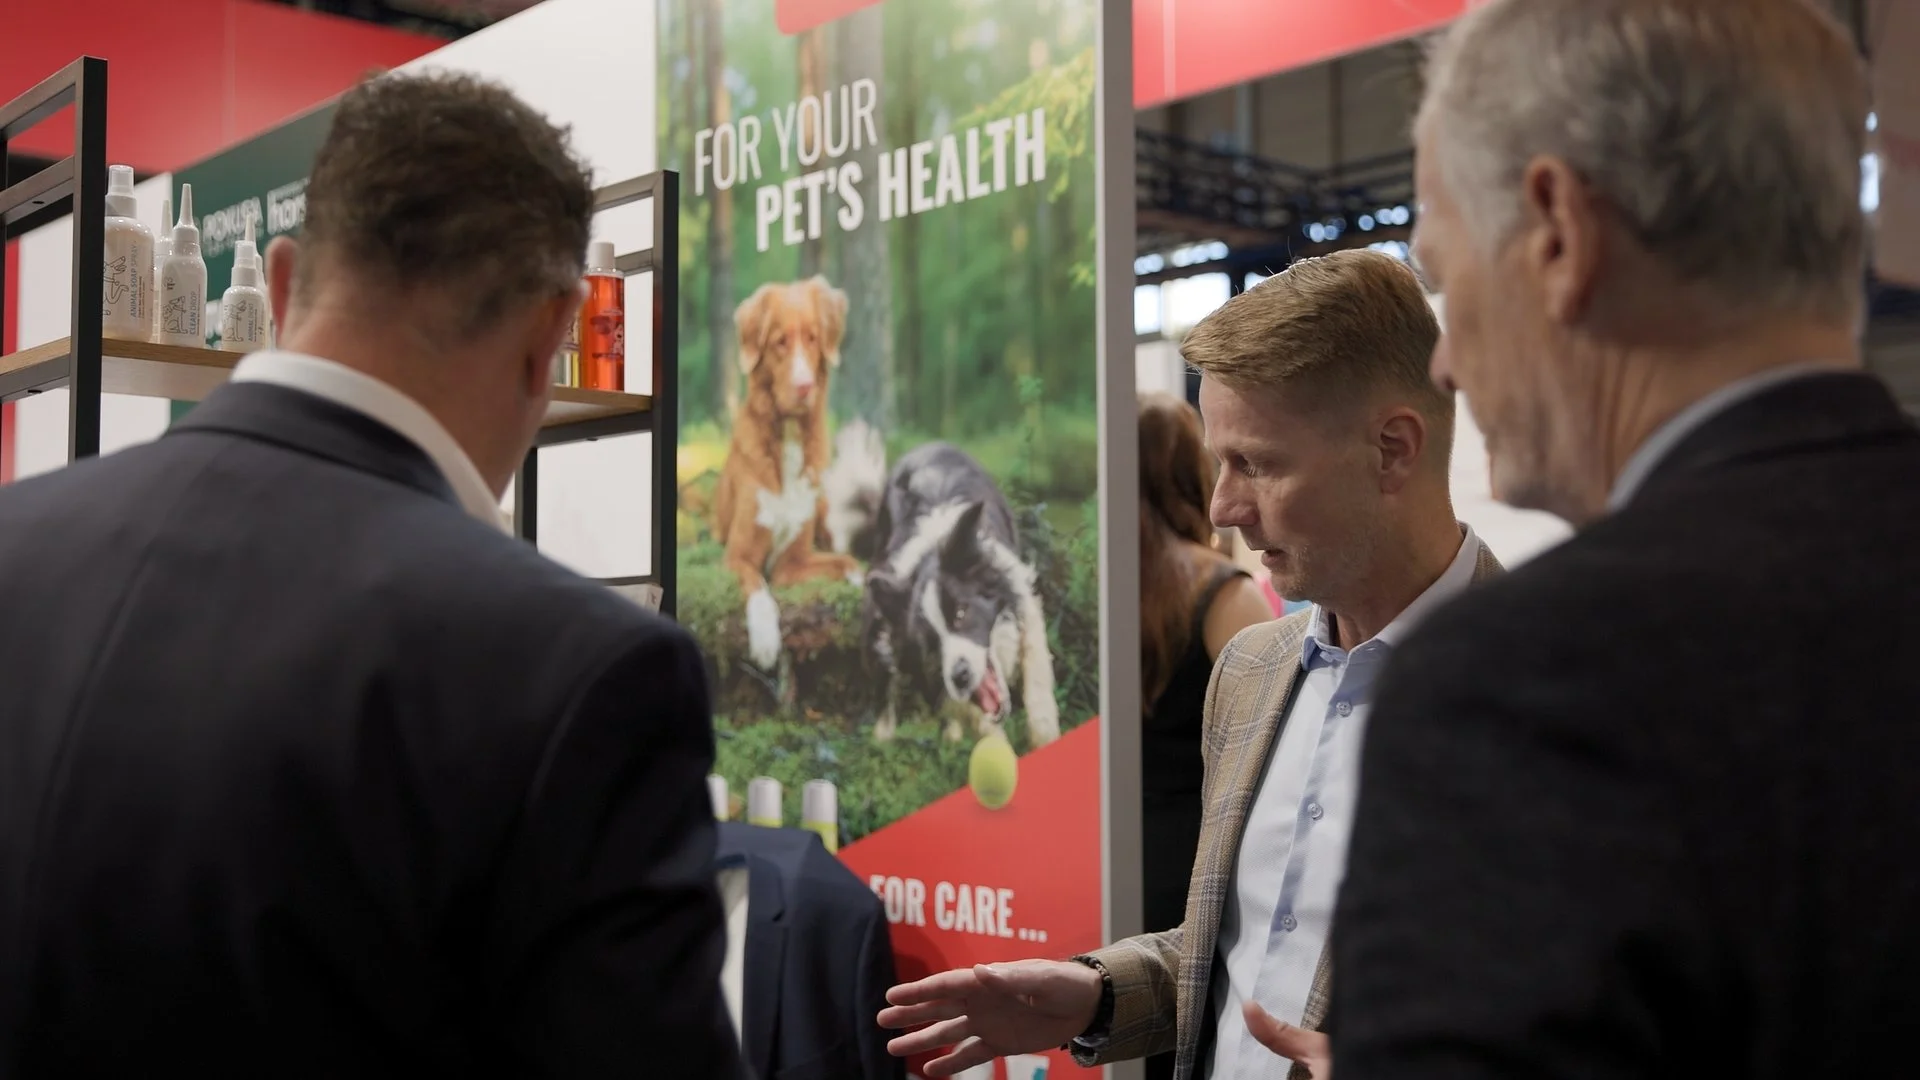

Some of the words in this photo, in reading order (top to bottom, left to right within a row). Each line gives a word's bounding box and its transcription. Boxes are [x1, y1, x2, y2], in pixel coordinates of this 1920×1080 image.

[694, 114, 762, 196] FOR
[771, 77, 878, 172] YOUR
[755, 160, 865, 252] PET'S
[878, 106, 1046, 222] HEALTH
[189, 290, 197, 311] DROP
[189, 312, 197, 335] CLEAN
